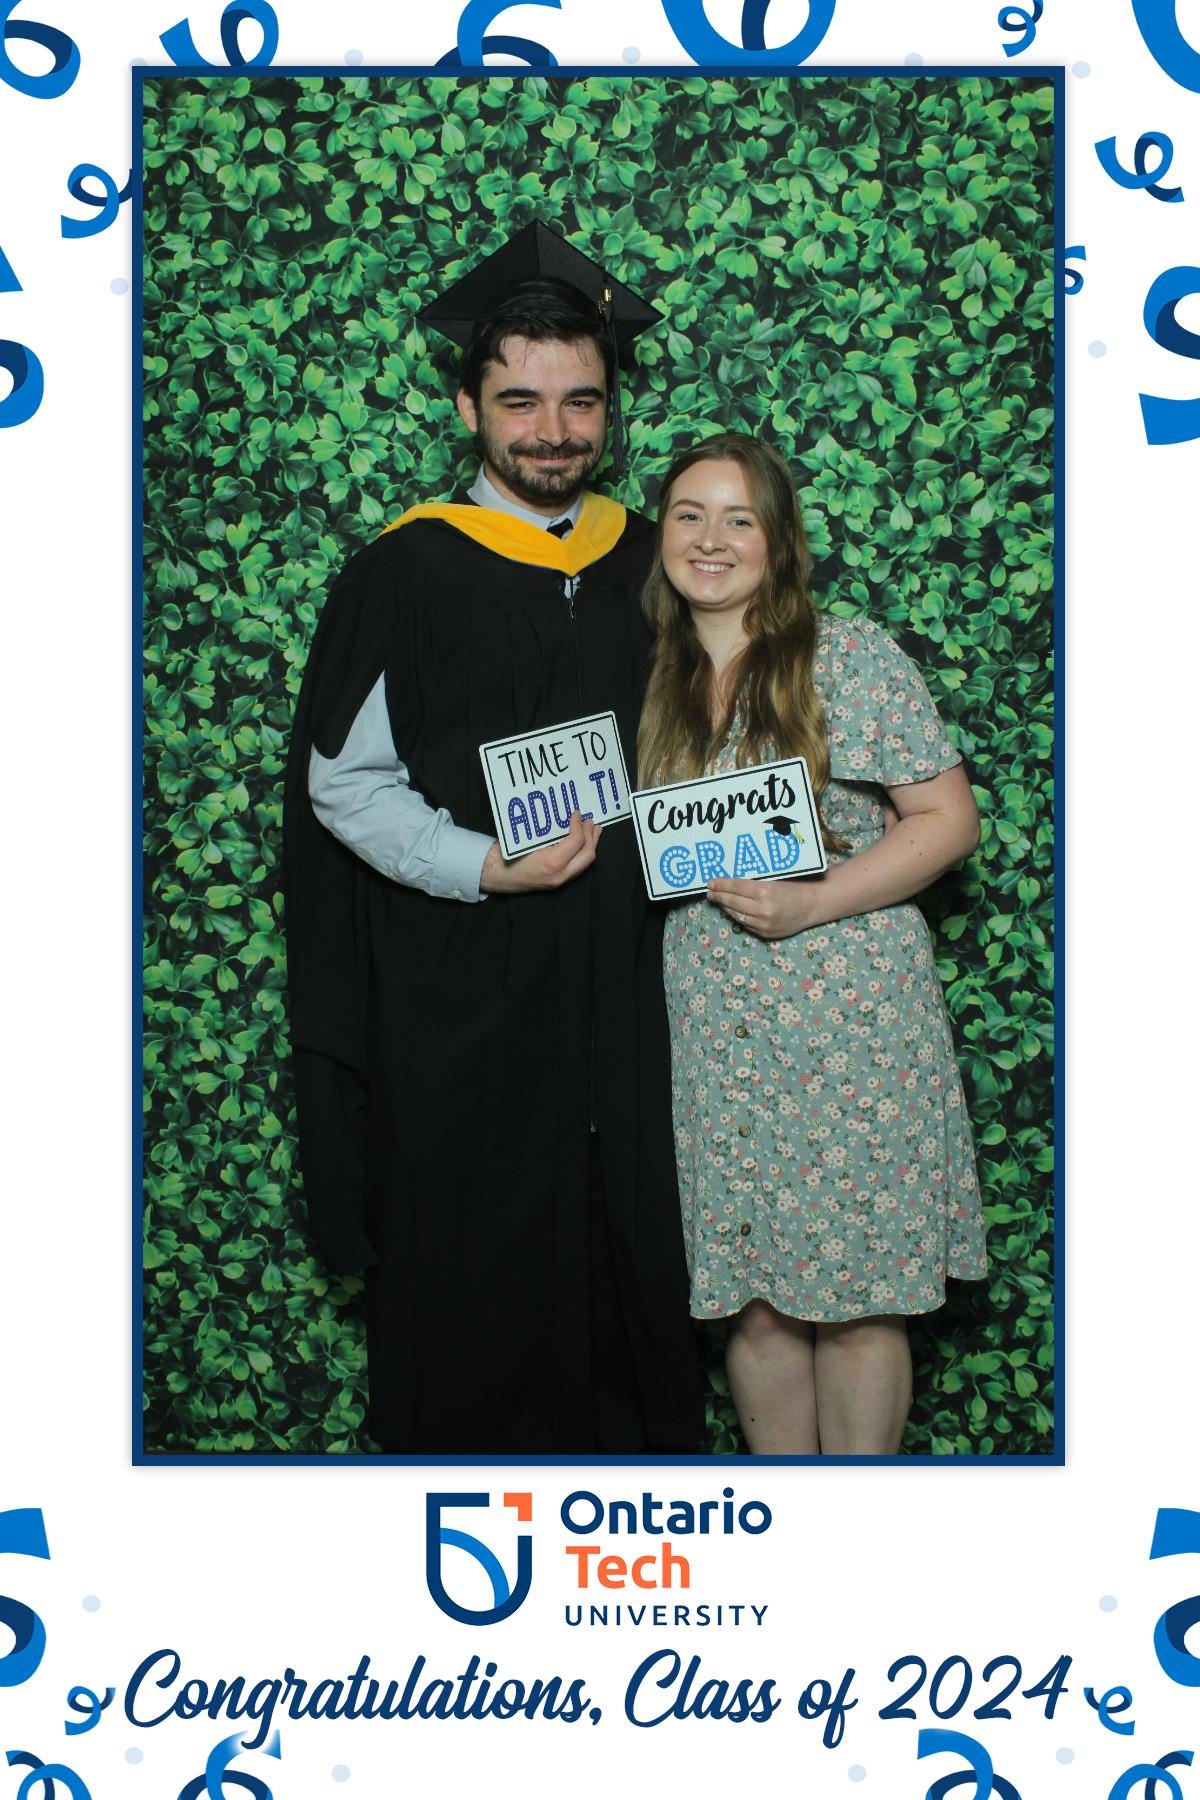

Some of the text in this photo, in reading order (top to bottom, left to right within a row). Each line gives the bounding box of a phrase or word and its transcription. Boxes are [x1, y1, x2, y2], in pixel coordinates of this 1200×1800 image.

[498, 730, 606, 787] TIME TO
[507, 768, 621, 845] ADULT!
[647, 773, 796, 834] Congrats
[659, 828, 801, 888] GRAD
